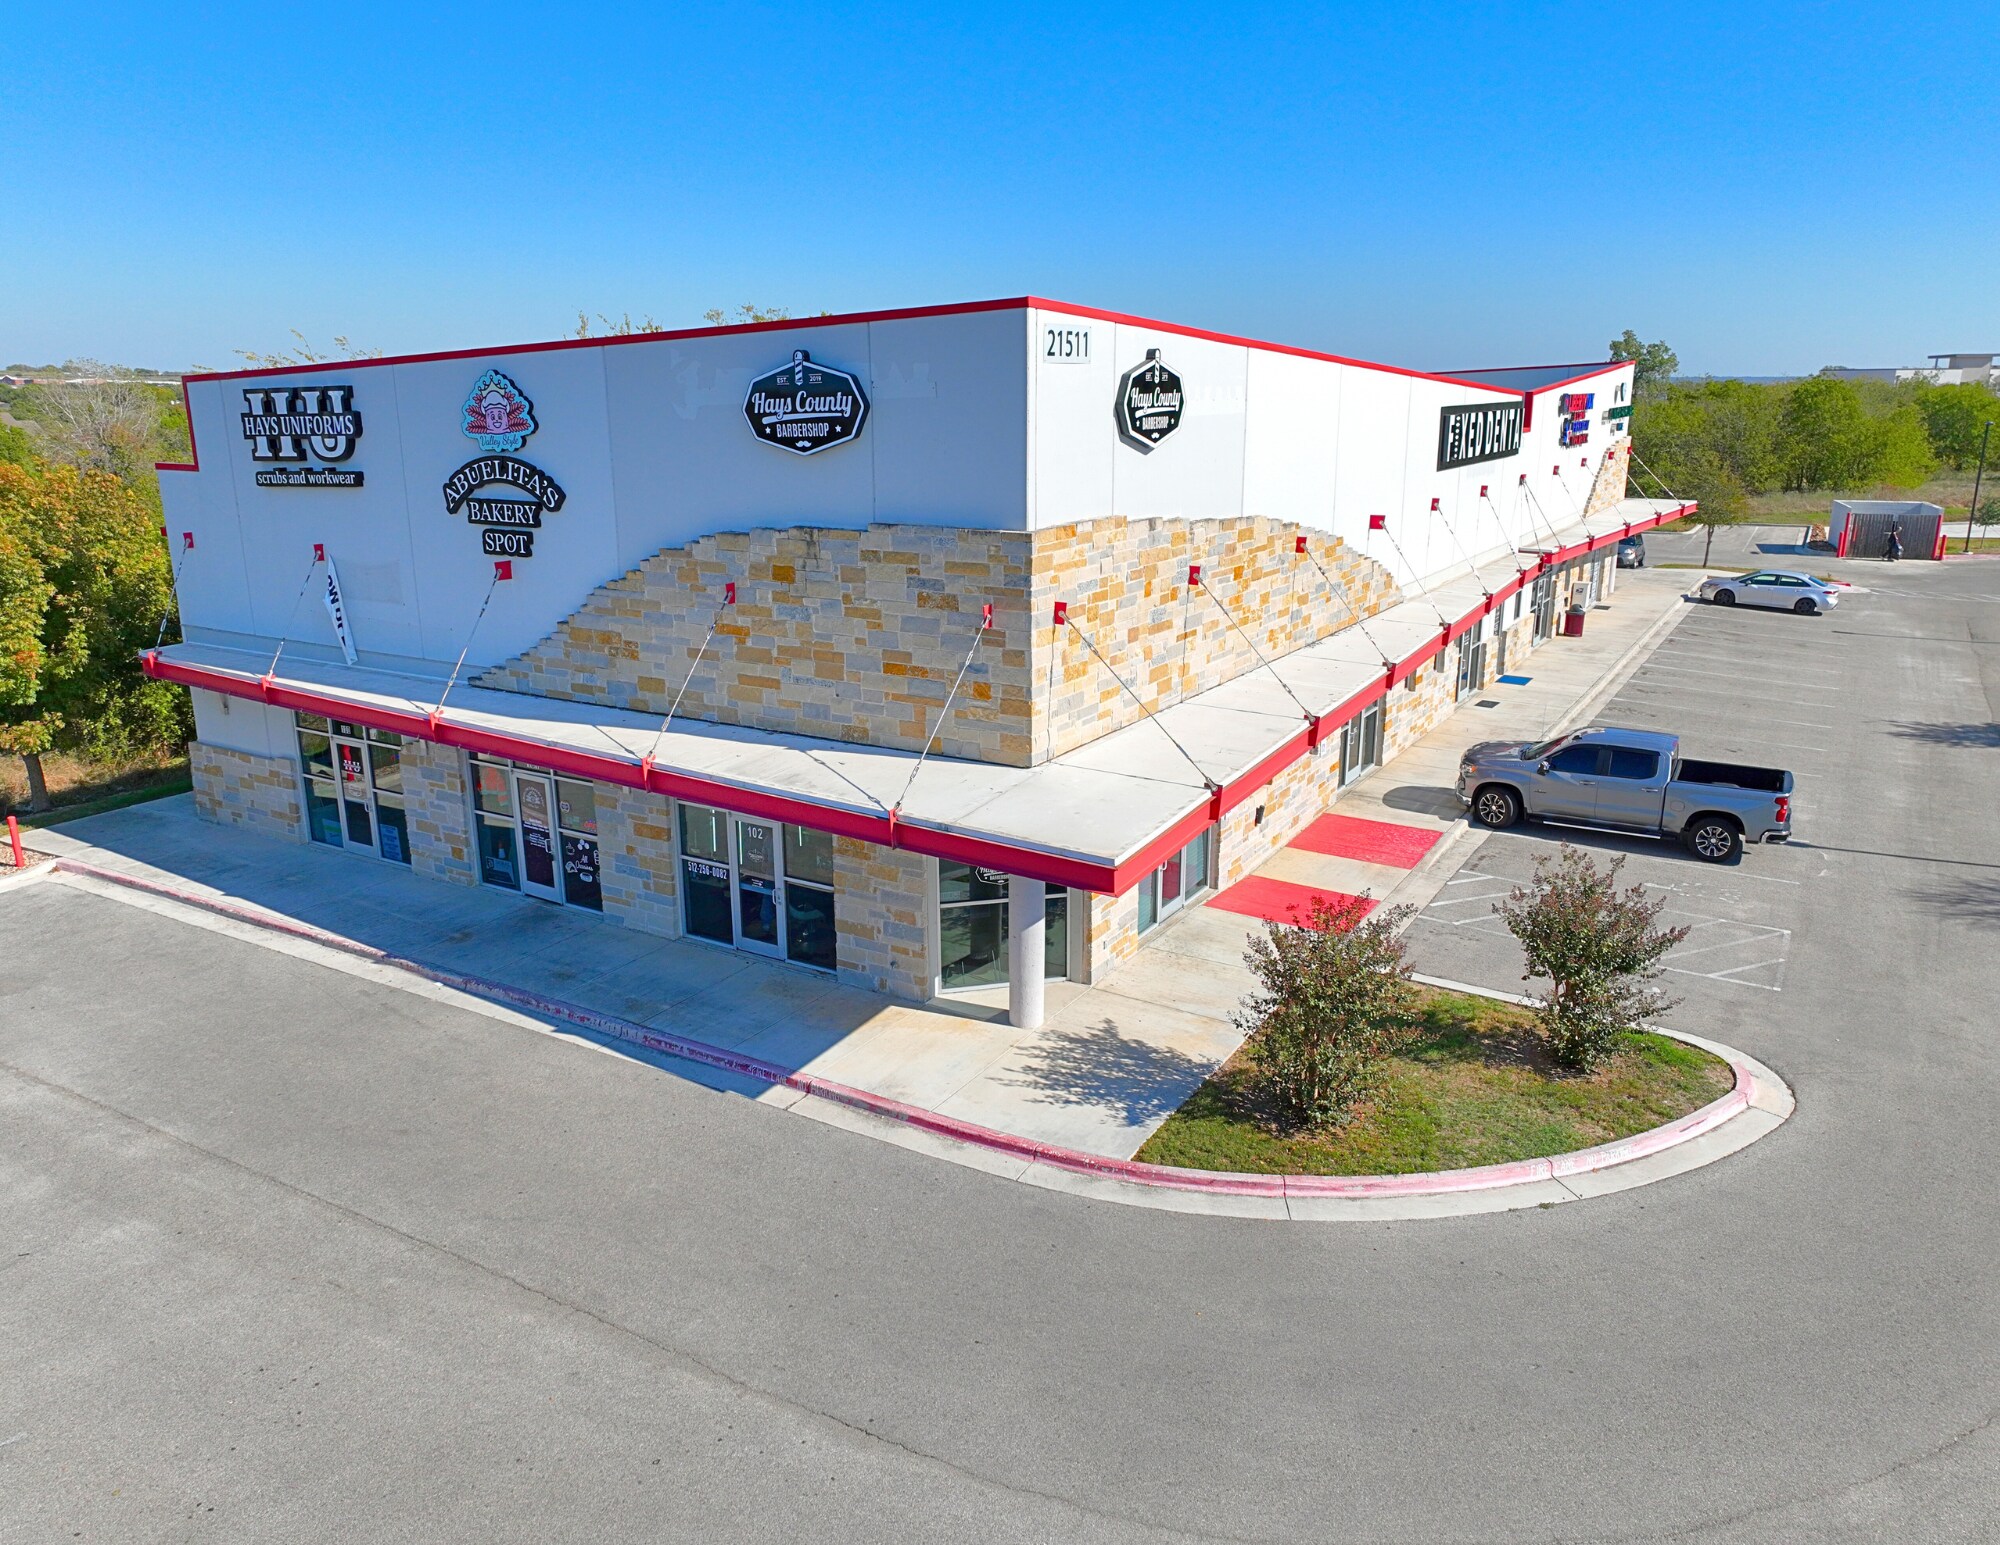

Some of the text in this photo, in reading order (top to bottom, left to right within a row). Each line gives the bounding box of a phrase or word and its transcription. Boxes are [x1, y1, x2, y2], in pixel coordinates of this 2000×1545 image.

[1047, 329, 1088, 357] 21511
[752, 391, 852, 420] Hays County
[1131, 387, 1181, 413] Hays County
[244, 415, 354, 435] HAYS UNIFORMS
[776, 422, 830, 438] BARBERSHOP
[1142, 416, 1169, 430] BARBERSHOP
[480, 435, 519, 447] Valley Style
[257, 471, 356, 484] scrubs and workwear
[445, 460, 559, 509] ABUELITA'S
[469, 502, 536, 524] BAKERY
[485, 533, 527, 553] SPOT
[747, 826, 763, 840] 102
[1530, 1161, 1550, 1177] FIRE
[1554, 1157, 1578, 1173] LANE
